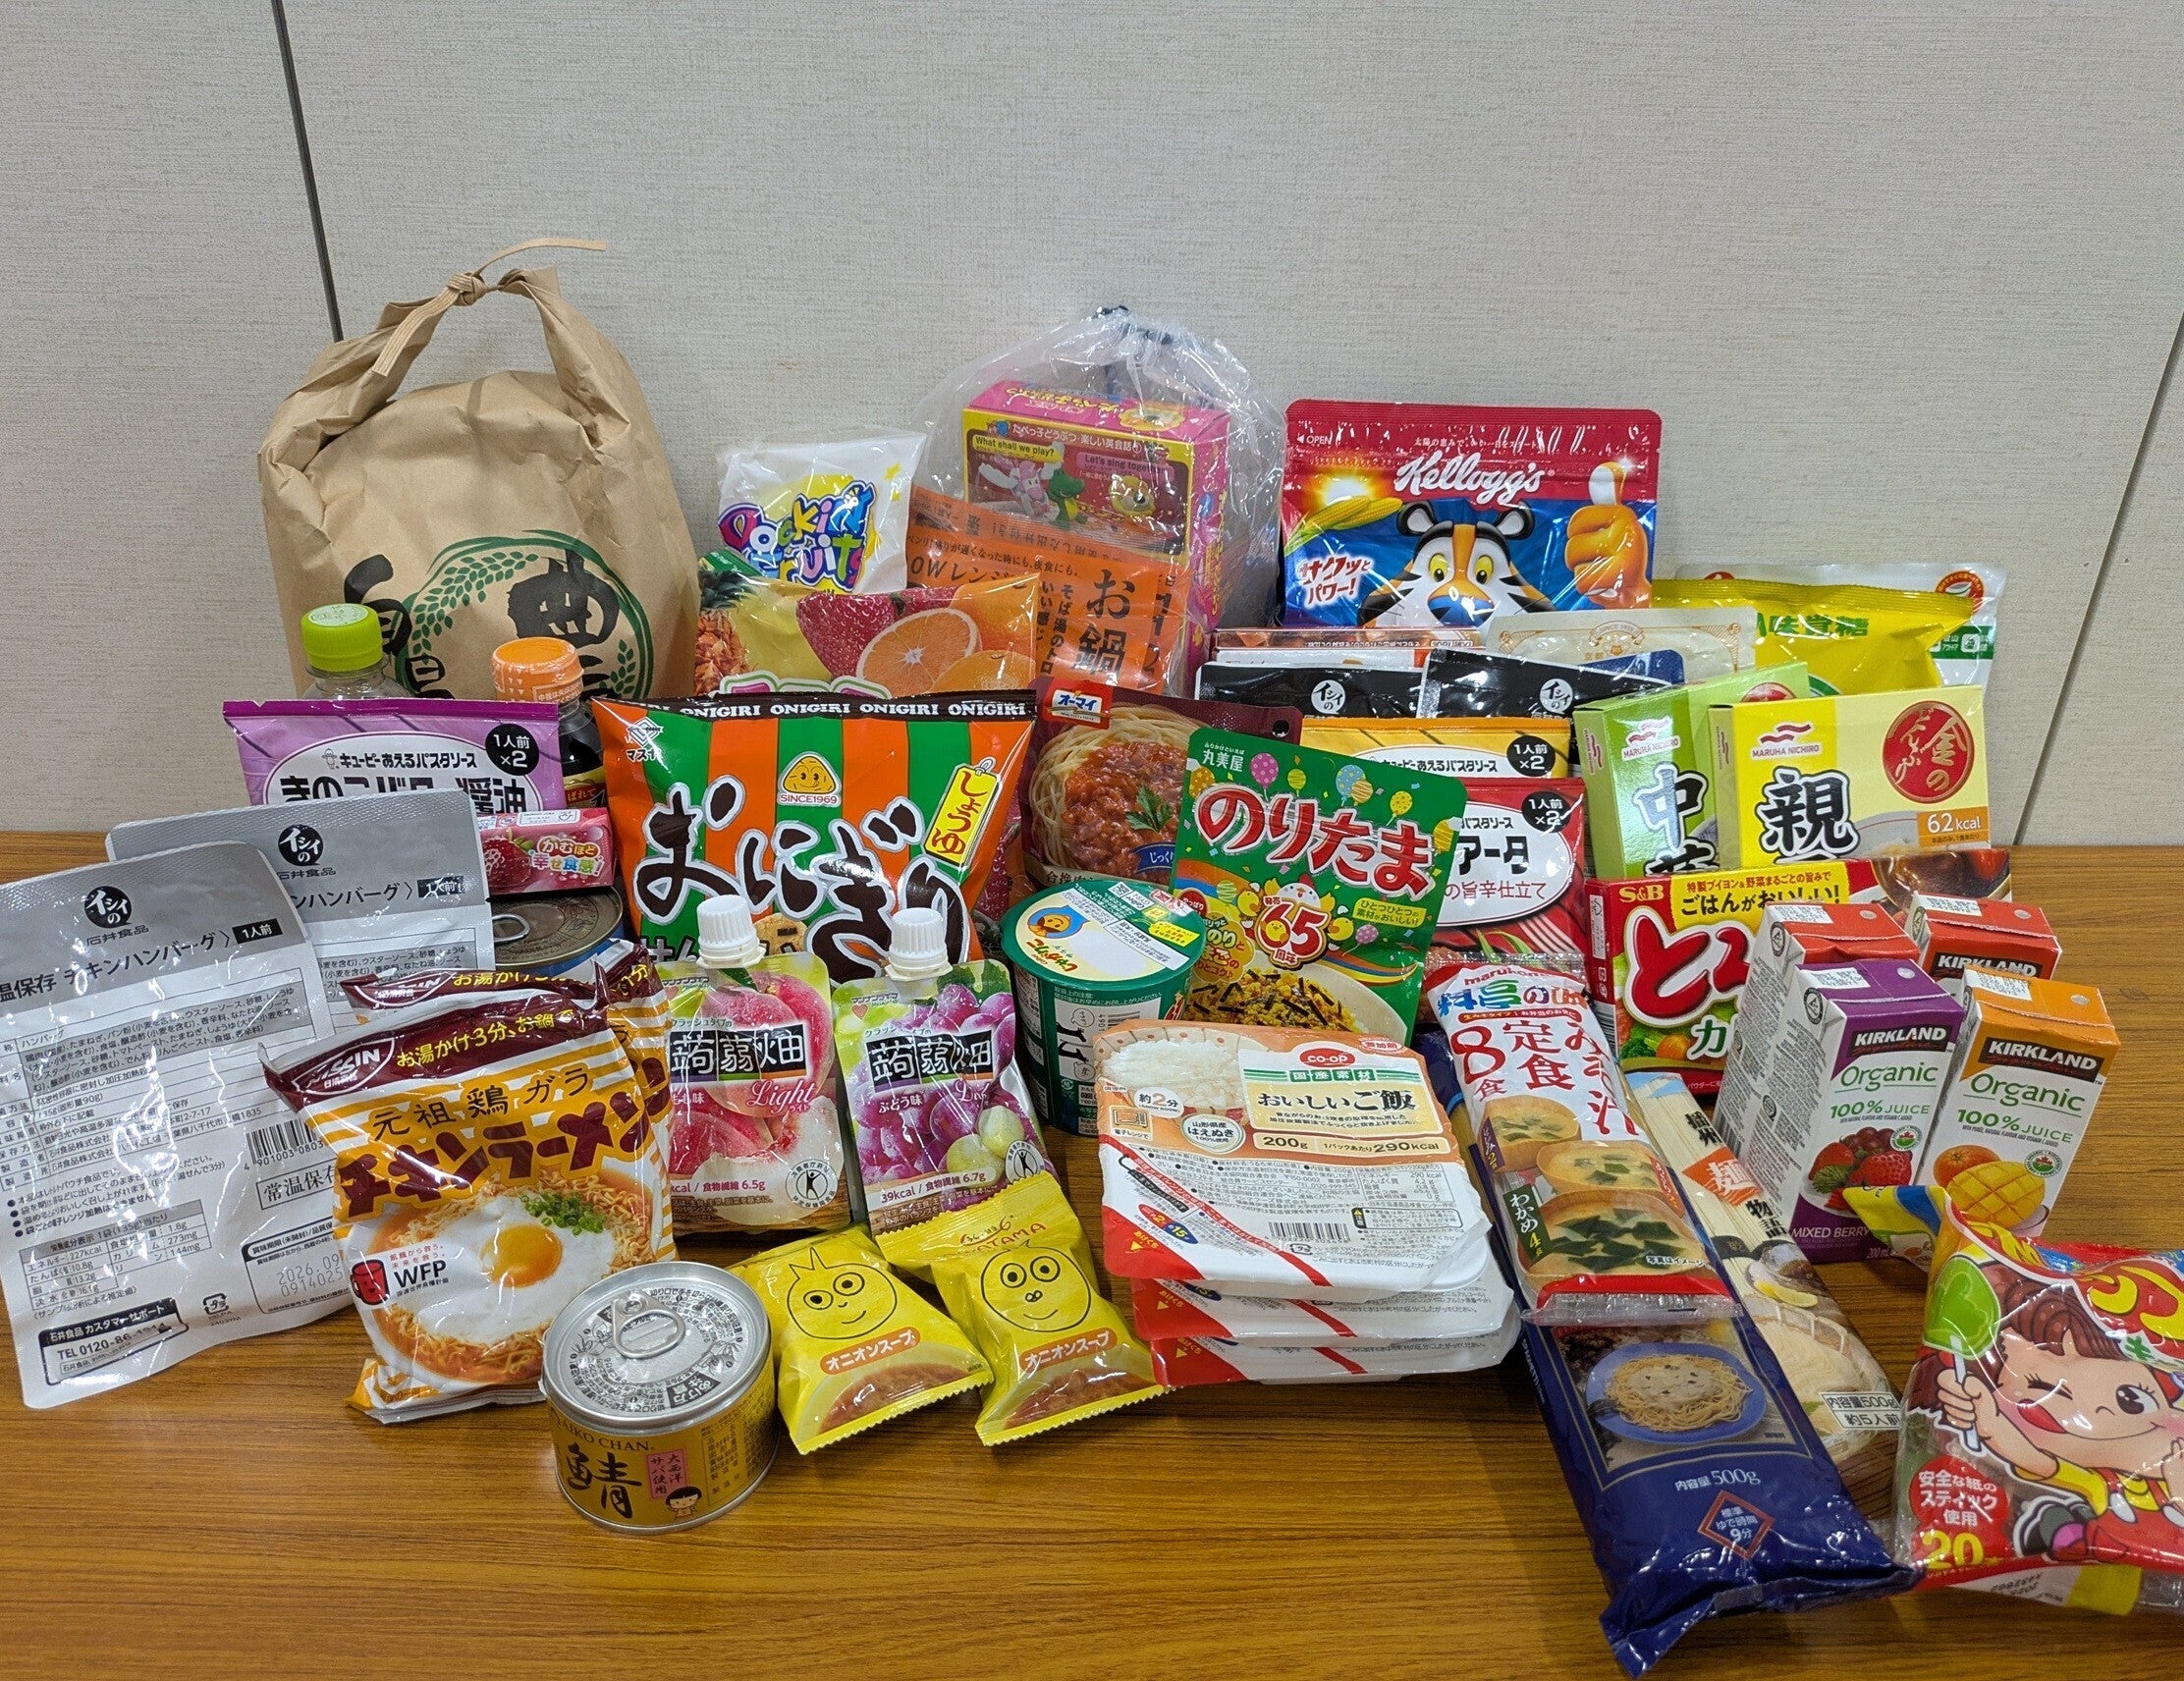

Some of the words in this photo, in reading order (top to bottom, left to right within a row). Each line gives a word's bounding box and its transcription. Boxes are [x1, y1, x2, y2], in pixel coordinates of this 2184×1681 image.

[975, 436, 996, 447] What
[997, 439, 1017, 451] shall
[1019, 444, 1031, 453] we
[1032, 447, 1055, 458] play?
[1306, 435, 1331, 445] OPEN
[1108, 458, 1125, 469] sing
[1393, 450, 1546, 505] Kellogg's
[1309, 582, 1356, 605] パワー!
[1074, 569, 1136, 679] お鍋
[1057, 693, 1098, 711] オーマイ
[1314, 681, 1343, 713] イシイの
[1542, 679, 1571, 711] イシイの
[770, 704, 850, 716] ONIGIRI
[859, 703, 939, 716] ONIGIRI
[948, 702, 1026, 716] ONIGIRI
[493, 734, 530, 750] 1人前
[1515, 743, 1549, 756] 1人前
[1752, 746, 1785, 758] MARUHA
[1787, 744, 1820, 756] NICHIRO
[1921, 715, 1967, 791] 金の
[339, 752, 477, 769] キューピーあえるパスタソース
[1203, 749, 1244, 773] 丸美屋
[930, 770, 989, 857] しょうゆ
[1528, 797, 1562, 810] 1人前
[1758, 771, 1855, 853] 親
[279, 827, 323, 866] イシイの
[540, 838, 598, 856] かむほど
[1195, 786, 1436, 899] のりたま
[276, 868, 337, 881] 石井食品
[532, 853, 605, 876] 幸せ食感!
[638, 782, 965, 978] おにぎり
[1686, 872, 1832, 894] 特製ブイヨン&野菜まるごとの旨みで
[1619, 885, 1666, 903] S&B
[1680, 883, 1843, 917] ごはんがおいしい!
[86, 888, 131, 927] イシイの
[1356, 907, 1420, 926] 素材がおいしい!
[1360, 899, 1420, 917] ひとつひとつの
[86, 925, 149, 947] 石井食品
[242, 924, 274, 941] 1人前
[1259, 900, 1329, 956] 65
[1275, 949, 1297, 964] 周年
[1854, 1027, 1947, 1047] KIRKLAND
[670, 1032, 806, 1076] 蒟蒻畑
[865, 1030, 994, 1083] 蒟蒻畑
[1502, 1019, 1576, 1092] 定食
[1988, 1040, 2098, 1070] KIRKLAND
[1839, 1061, 1938, 1092] Organic
[746, 1079, 817, 1114] Light
[877, 1093, 924, 1114] ぶどう味
[1138, 1092, 1179, 1109] 約2分
[1257, 1089, 1417, 1112] おいしいご飯
[1970, 1072, 2086, 1112] Organic
[373, 1067, 589, 1142] 元祖鶏ガラ
[790, 1104, 810, 1112] ライト
[1829, 1100, 1884, 1119] 100%
[1884, 1105, 1931, 1114] JUICE
[1187, 1128, 1234, 1138] はえぬき
[1956, 1109, 2021, 1131] 100%
[2021, 1125, 2074, 1144] JUICE
[338, 1090, 648, 1218] チキンラーメン
[1263, 1137, 1309, 1150] 200g
[1374, 1142, 1440, 1153] 290kcal
[702, 1181, 739, 1193] 食物繊維
[741, 1179, 766, 1192] 6.5g
[880, 1184, 916, 1204] 39kcal
[925, 1176, 960, 1192] 食物繊維
[962, 1171, 987, 1183] 6.7g
[1510, 1192, 1540, 1234] わかめ
[167, 1231, 198, 1245] 273mg
[1791, 1226, 1832, 1238] MIXED
[276, 1254, 341, 1286] 2026.09
[394, 1259, 449, 1289] WFP
[280, 1268, 344, 1298] 0914025
[49, 1328, 84, 1343] 石井食品
[57, 1349, 79, 1361] TEL
[825, 1328, 917, 1372] オニオンスープ
[1023, 1329, 1113, 1372] オニオンスープ
[1844, 1411, 1900, 1428] 約5人前
[598, 1437, 650, 1451] CHAN
[566, 1441, 643, 1519] 鯖
[649, 1455, 668, 1494] サバ使用
[668, 1453, 684, 1484] 大西洋
[1674, 1476, 1711, 1491] 内容量
[1711, 1468, 1761, 1487] 500g
[1918, 1470, 1998, 1492] 安全な紙の
[1919, 1488, 1999, 1511] スティック
[1942, 1509, 1978, 1528] 使用
[1729, 1526, 1753, 1544] 9分
[1921, 1530, 1985, 1570] 20
